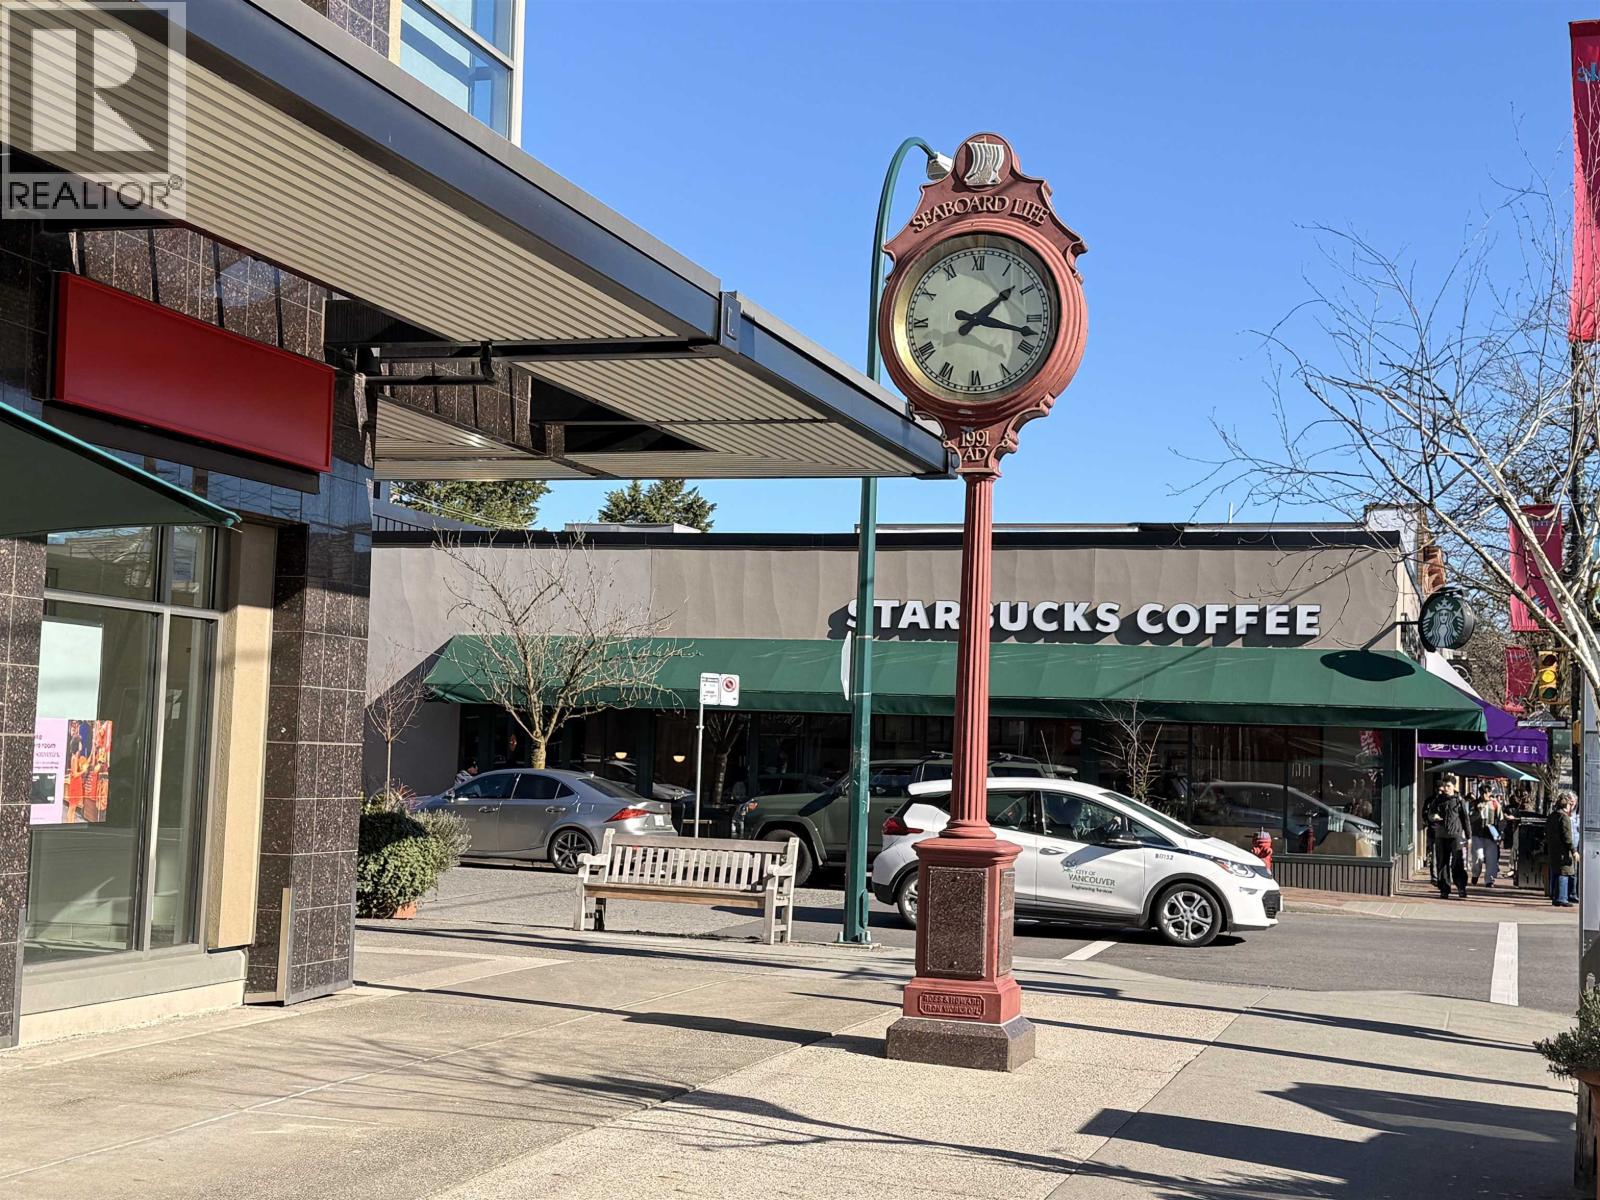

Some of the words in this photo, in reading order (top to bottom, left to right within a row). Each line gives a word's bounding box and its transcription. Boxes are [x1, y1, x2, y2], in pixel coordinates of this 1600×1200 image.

[912, 196, 1010, 232] SEABOARD
[1012, 198, 1050, 226] LIFE
[961, 430, 991, 447] 1991
[963, 447, 988, 461] AD
[846, 599, 1121, 633] TARUCKS
[1136, 603, 1321, 636] COFFEE
[1451, 743, 1538, 754] CHOCOLATIER
[1069, 874, 1116, 887] VANCOUVER
